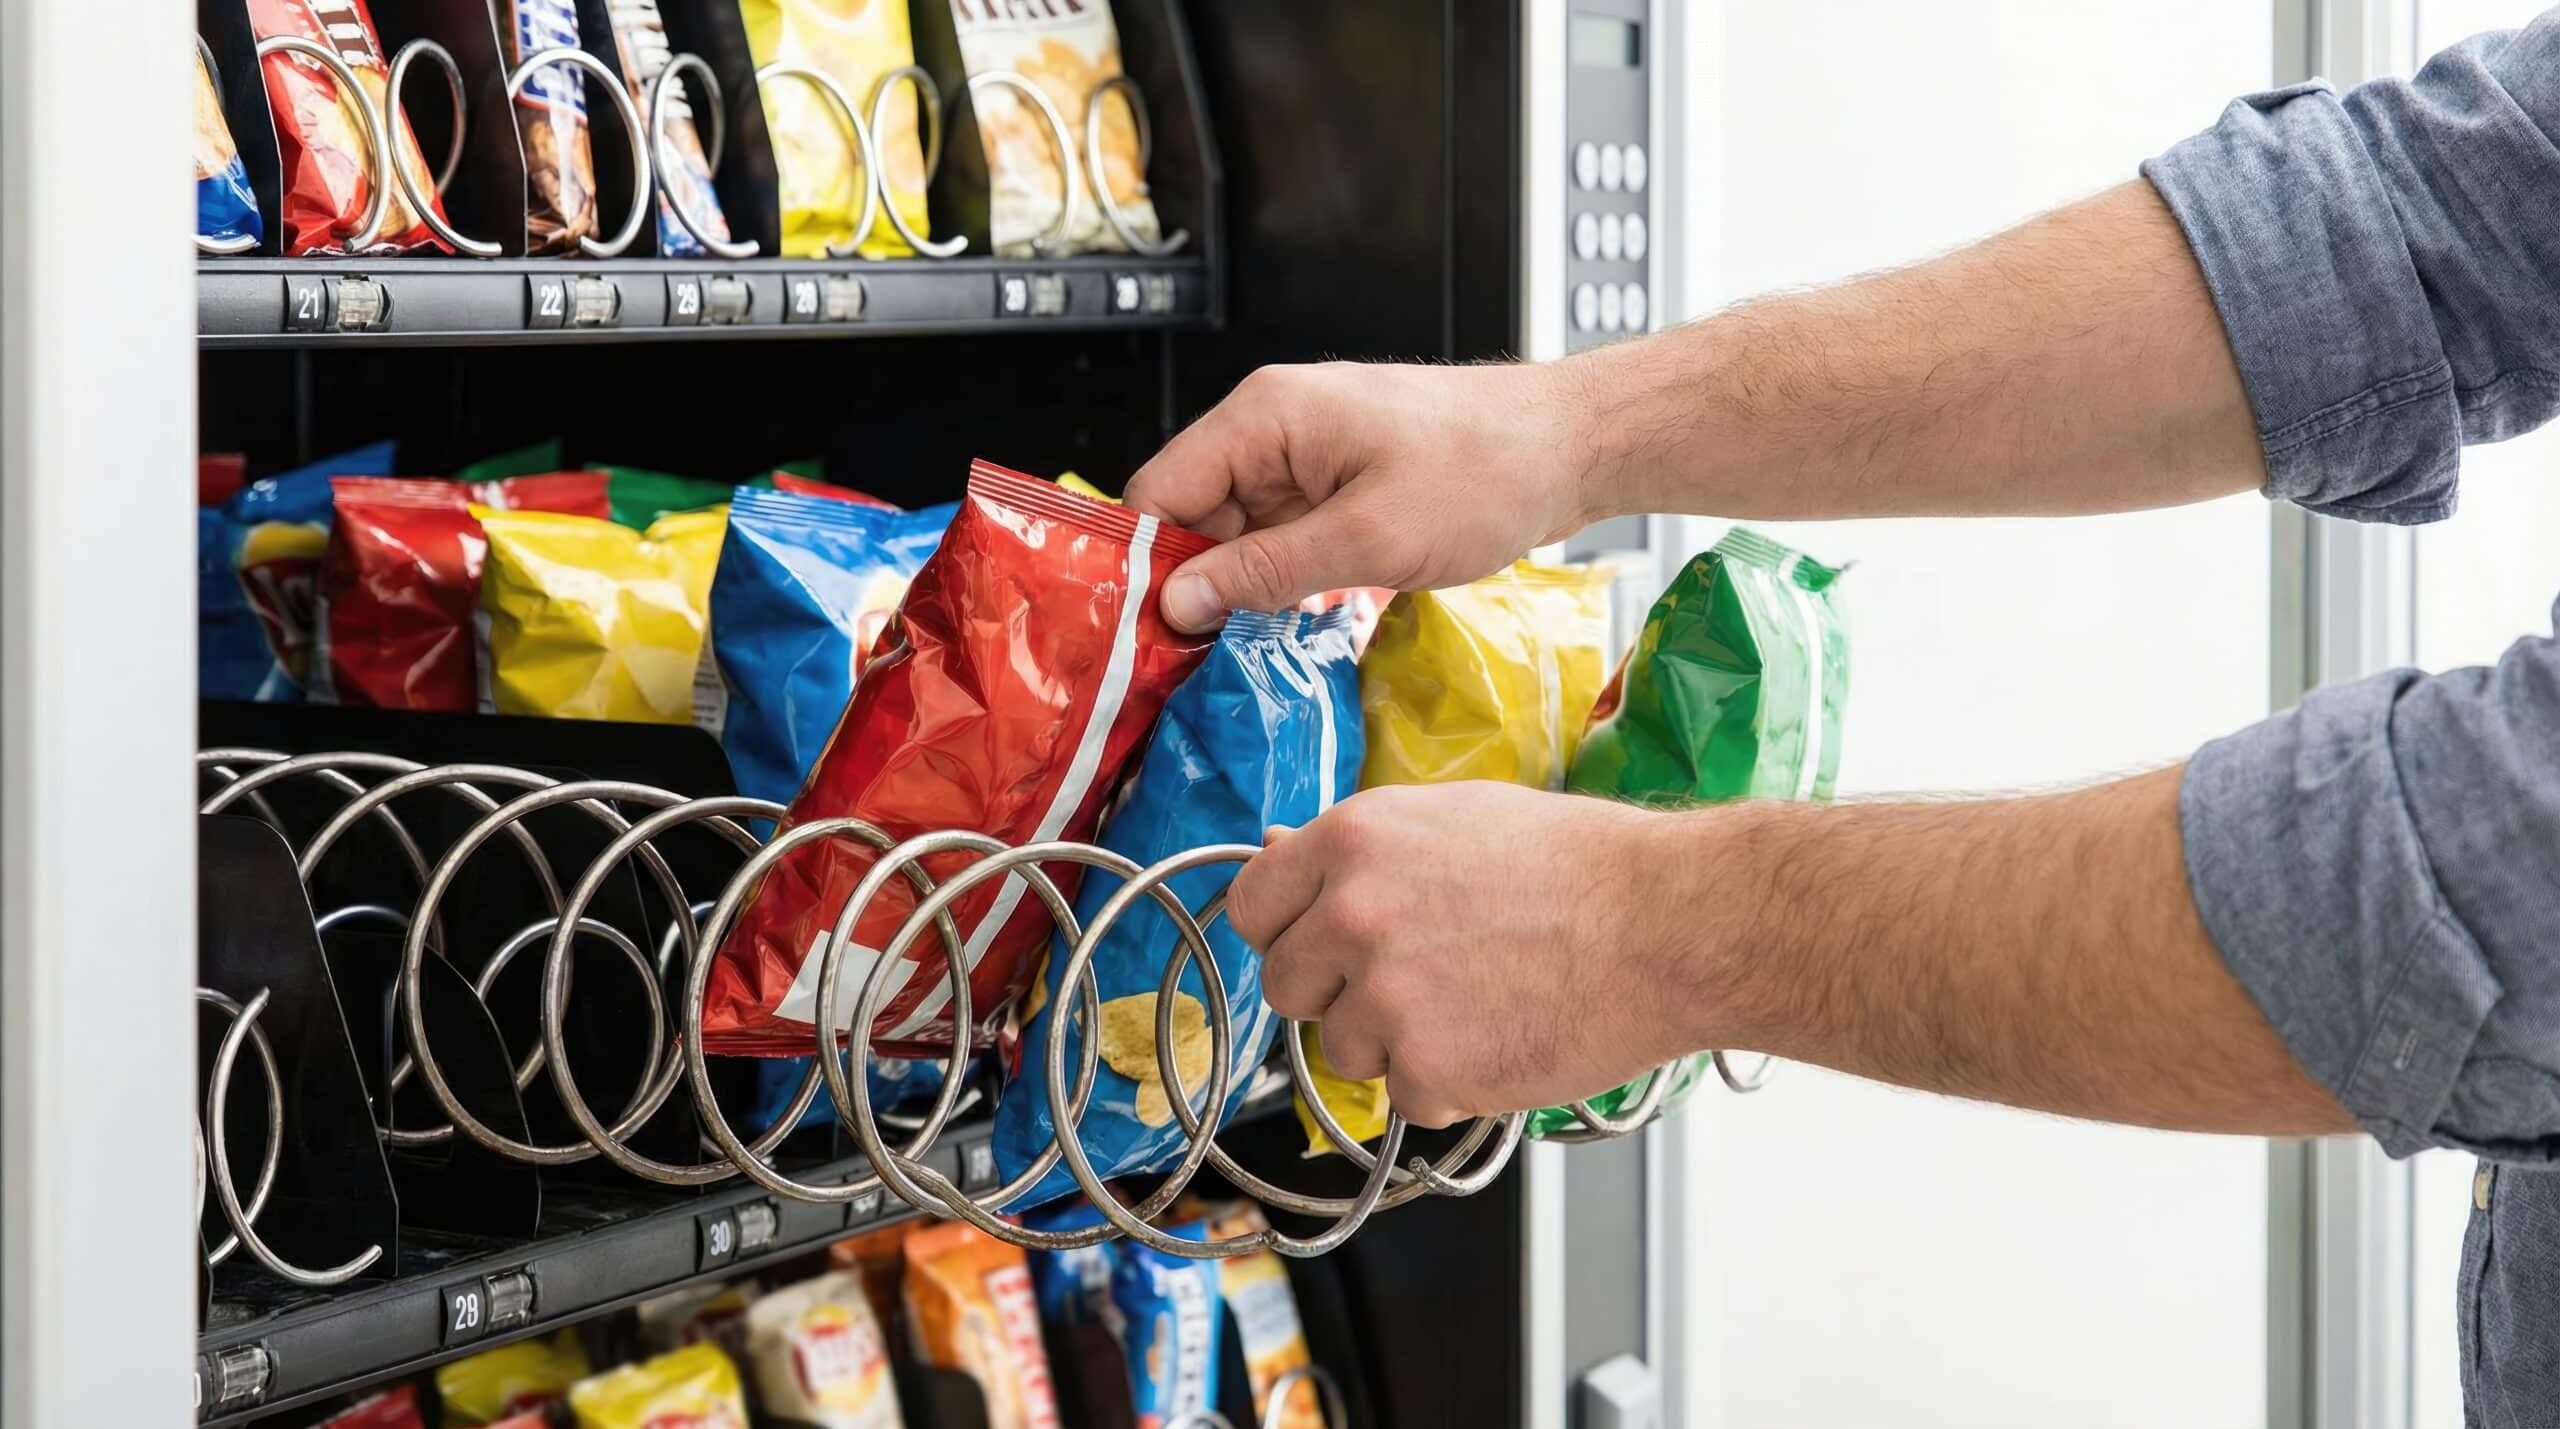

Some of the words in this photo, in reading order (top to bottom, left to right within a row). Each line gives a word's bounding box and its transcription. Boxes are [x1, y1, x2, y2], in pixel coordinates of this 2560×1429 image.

[298, 287, 320, 319] 21
[540, 284, 562, 316] 22
[710, 1220, 731, 1256] 30
